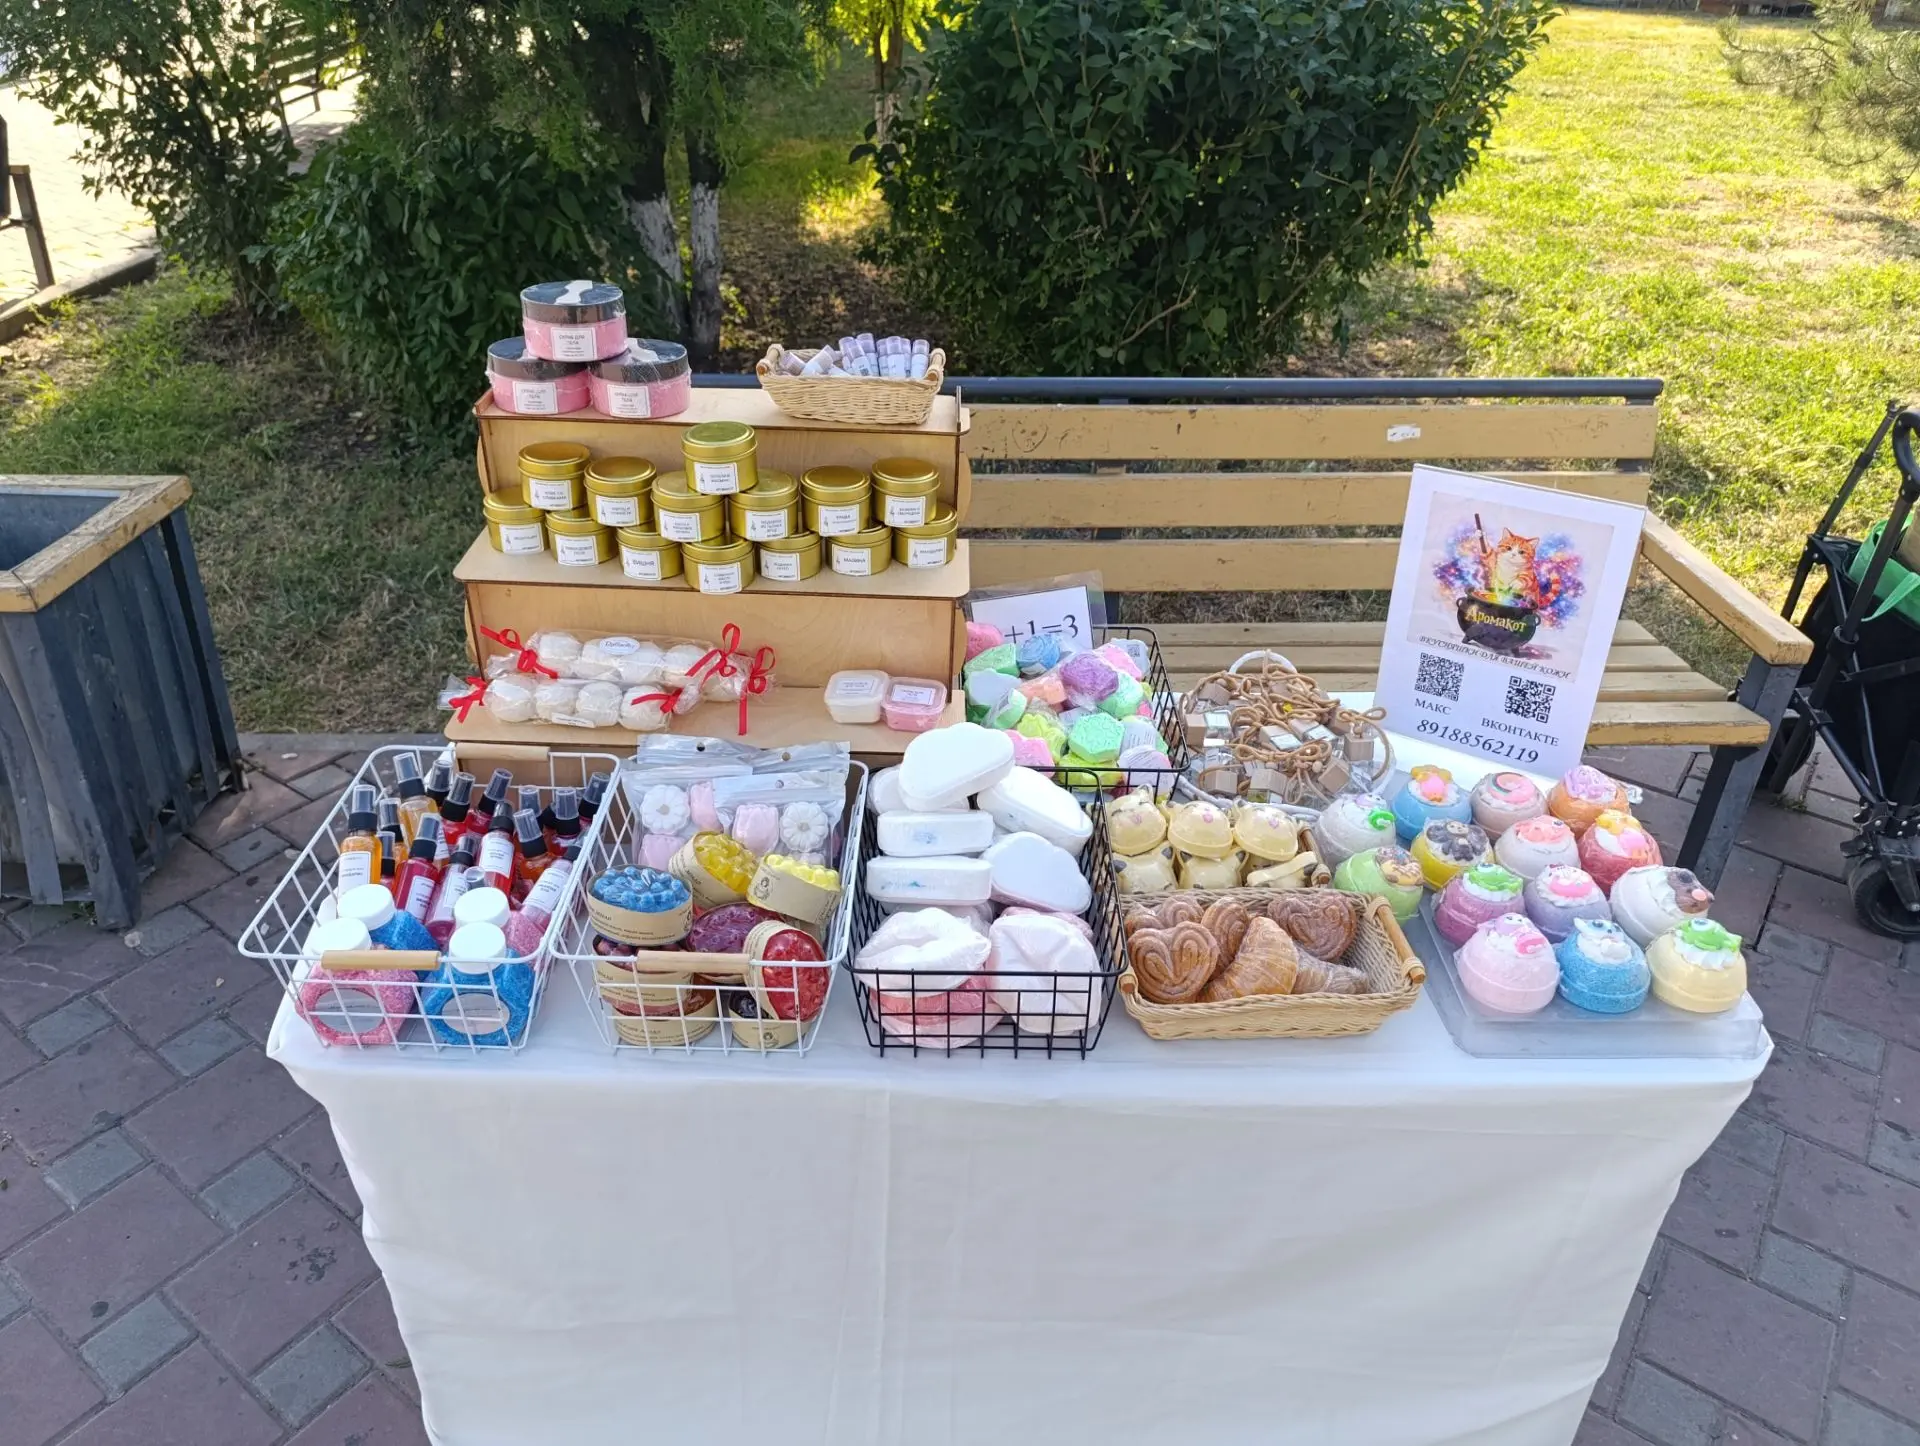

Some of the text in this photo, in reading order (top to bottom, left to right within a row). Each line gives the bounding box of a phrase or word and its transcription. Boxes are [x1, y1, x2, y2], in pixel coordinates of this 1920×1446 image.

[1464, 603, 1527, 633] Аромакот
[1418, 635, 1572, 679] ВКУСНЯШКИ ДЛЯ ВАШЕЙ КОЖИ
[1414, 697, 1452, 716] МАКС
[1416, 719, 1539, 764] 89188562119
[1481, 717, 1560, 747] ВКОНТАКТЕ
